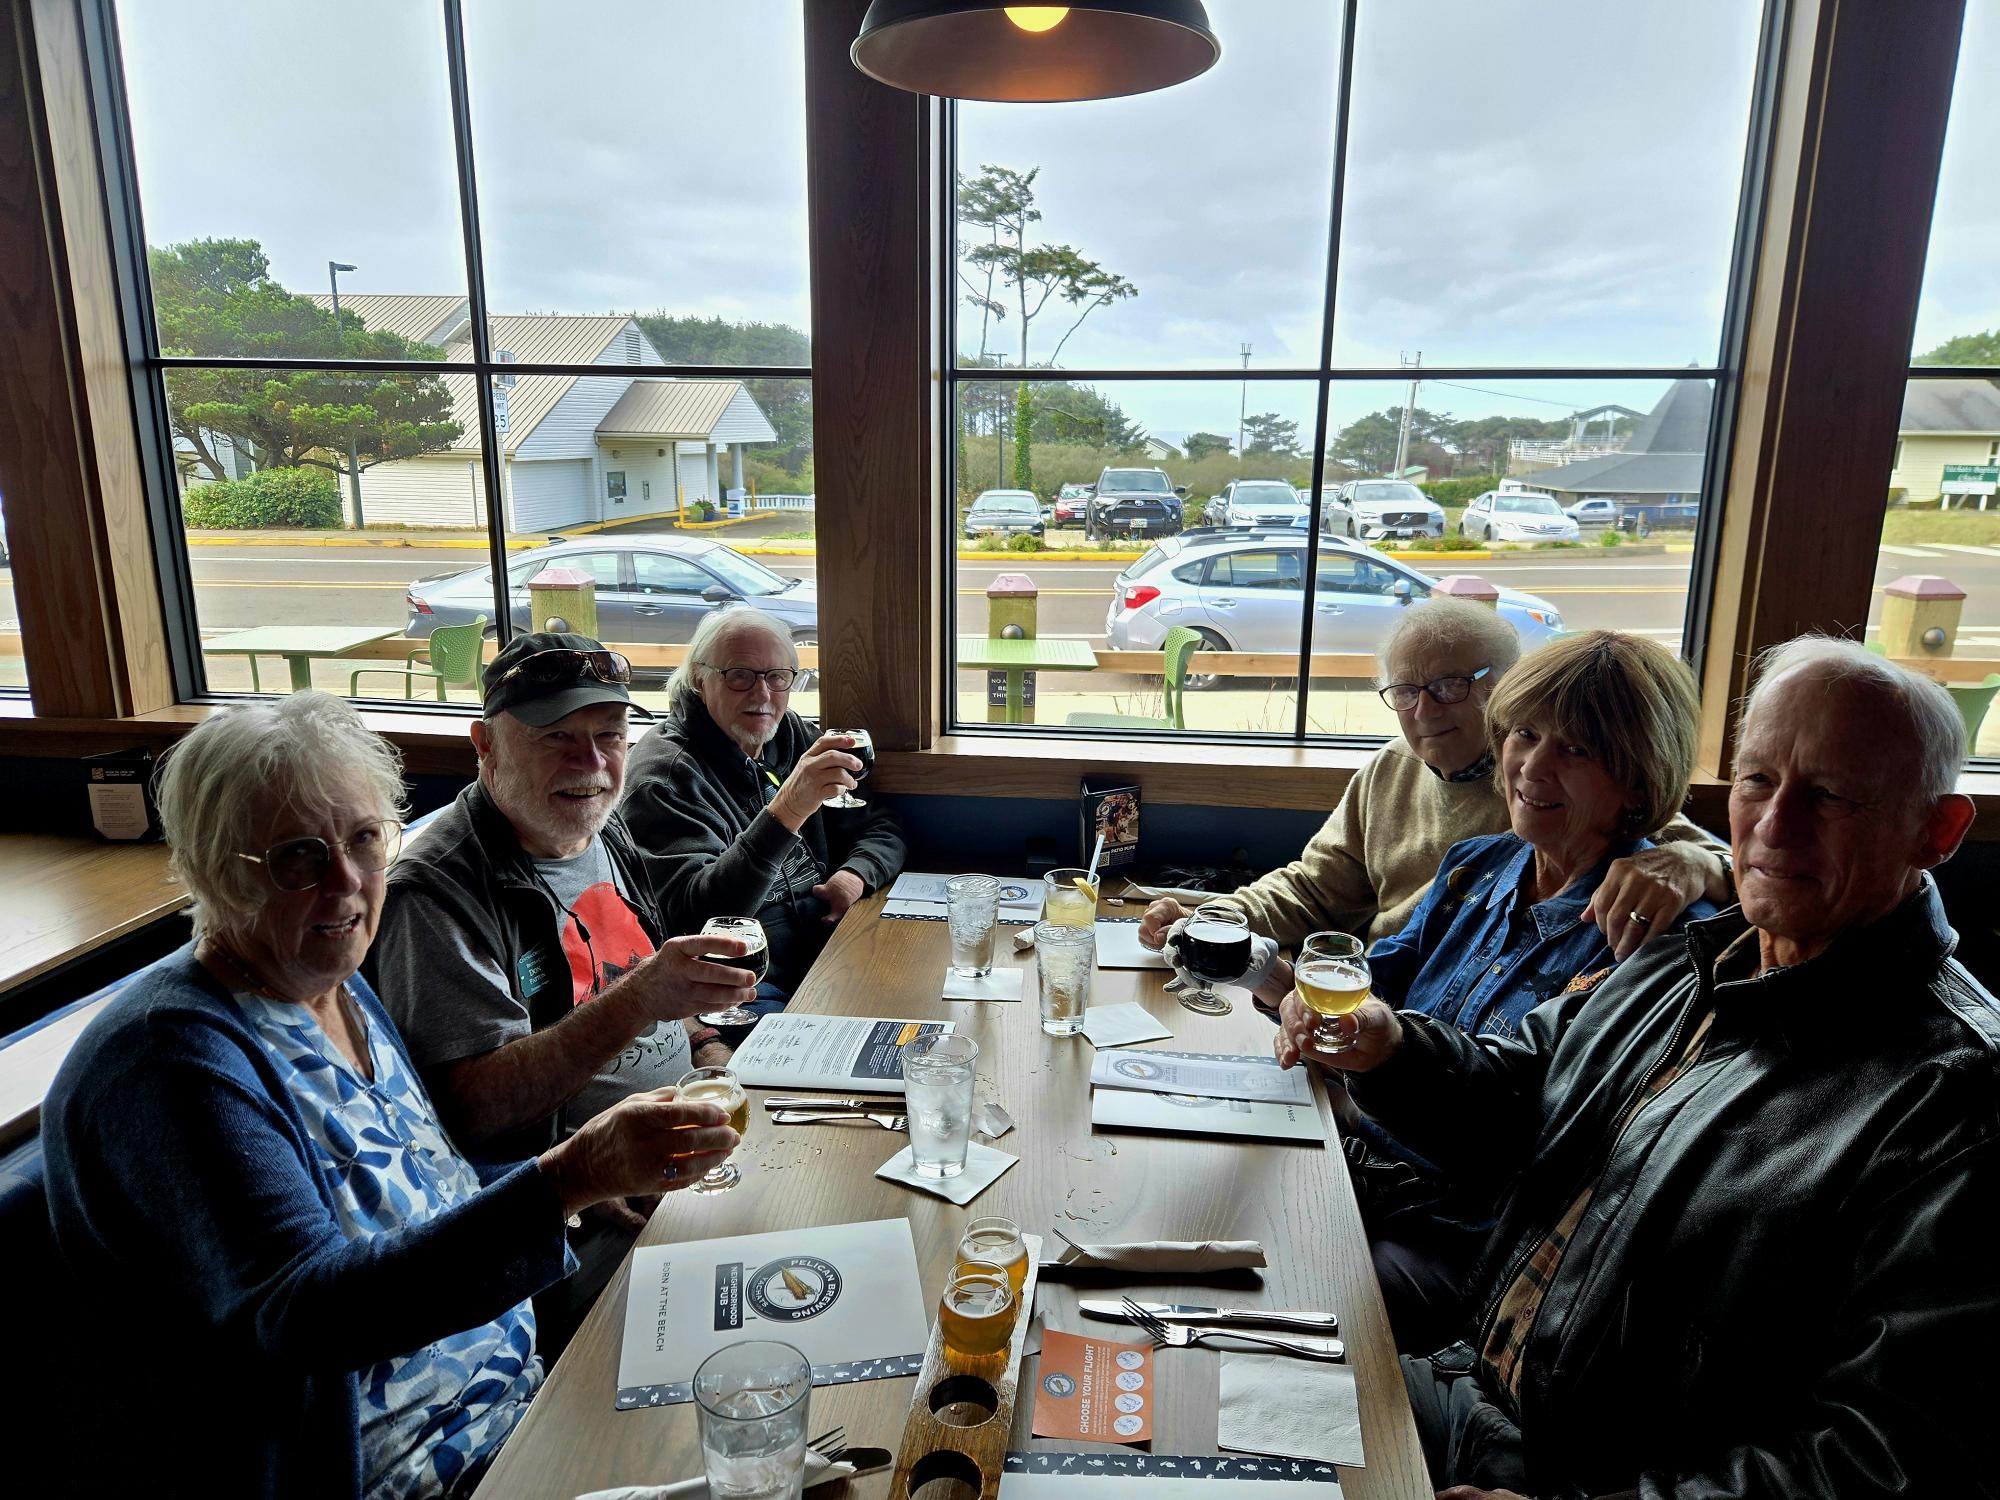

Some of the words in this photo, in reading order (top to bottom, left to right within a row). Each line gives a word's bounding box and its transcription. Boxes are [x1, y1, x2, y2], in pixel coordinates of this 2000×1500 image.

[661, 1262, 670, 1284] BORN
[791, 1259, 836, 1282] PELICAN
[660, 1286, 668, 1297] AT
[720, 1286, 729, 1306] PUB
[730, 1266, 738, 1326] NEIGHBORHOOD
[791, 1283, 836, 1319] BREWING
[658, 1299, 668, 1318] THE
[656, 1319, 666, 1352] BEACH
[1084, 1344, 1094, 1373] FLIGHT
[1083, 1375, 1092, 1397] YOUR
[1080, 1398, 1091, 1434] CHOOSE
